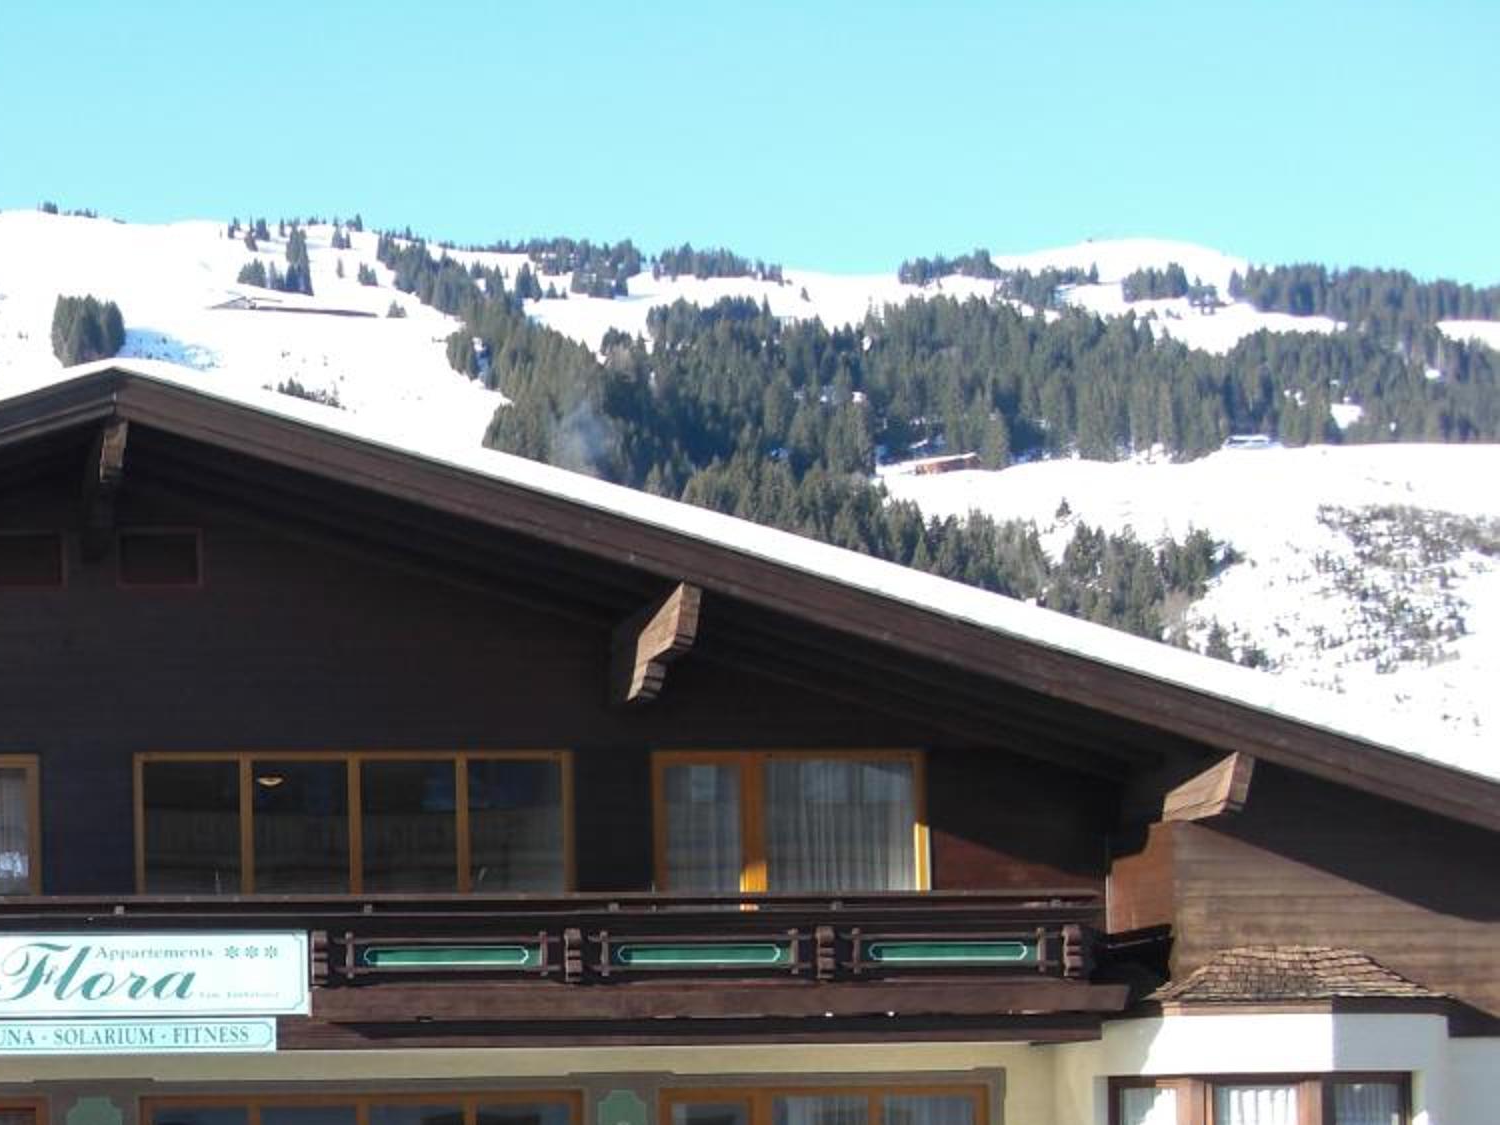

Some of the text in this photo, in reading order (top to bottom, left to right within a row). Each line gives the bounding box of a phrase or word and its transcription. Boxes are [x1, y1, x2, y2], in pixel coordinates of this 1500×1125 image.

[95, 945, 214, 961] Appartements
[53, 1027, 156, 1046] SOLARIUM
[173, 1025, 250, 1044] FITNESS
